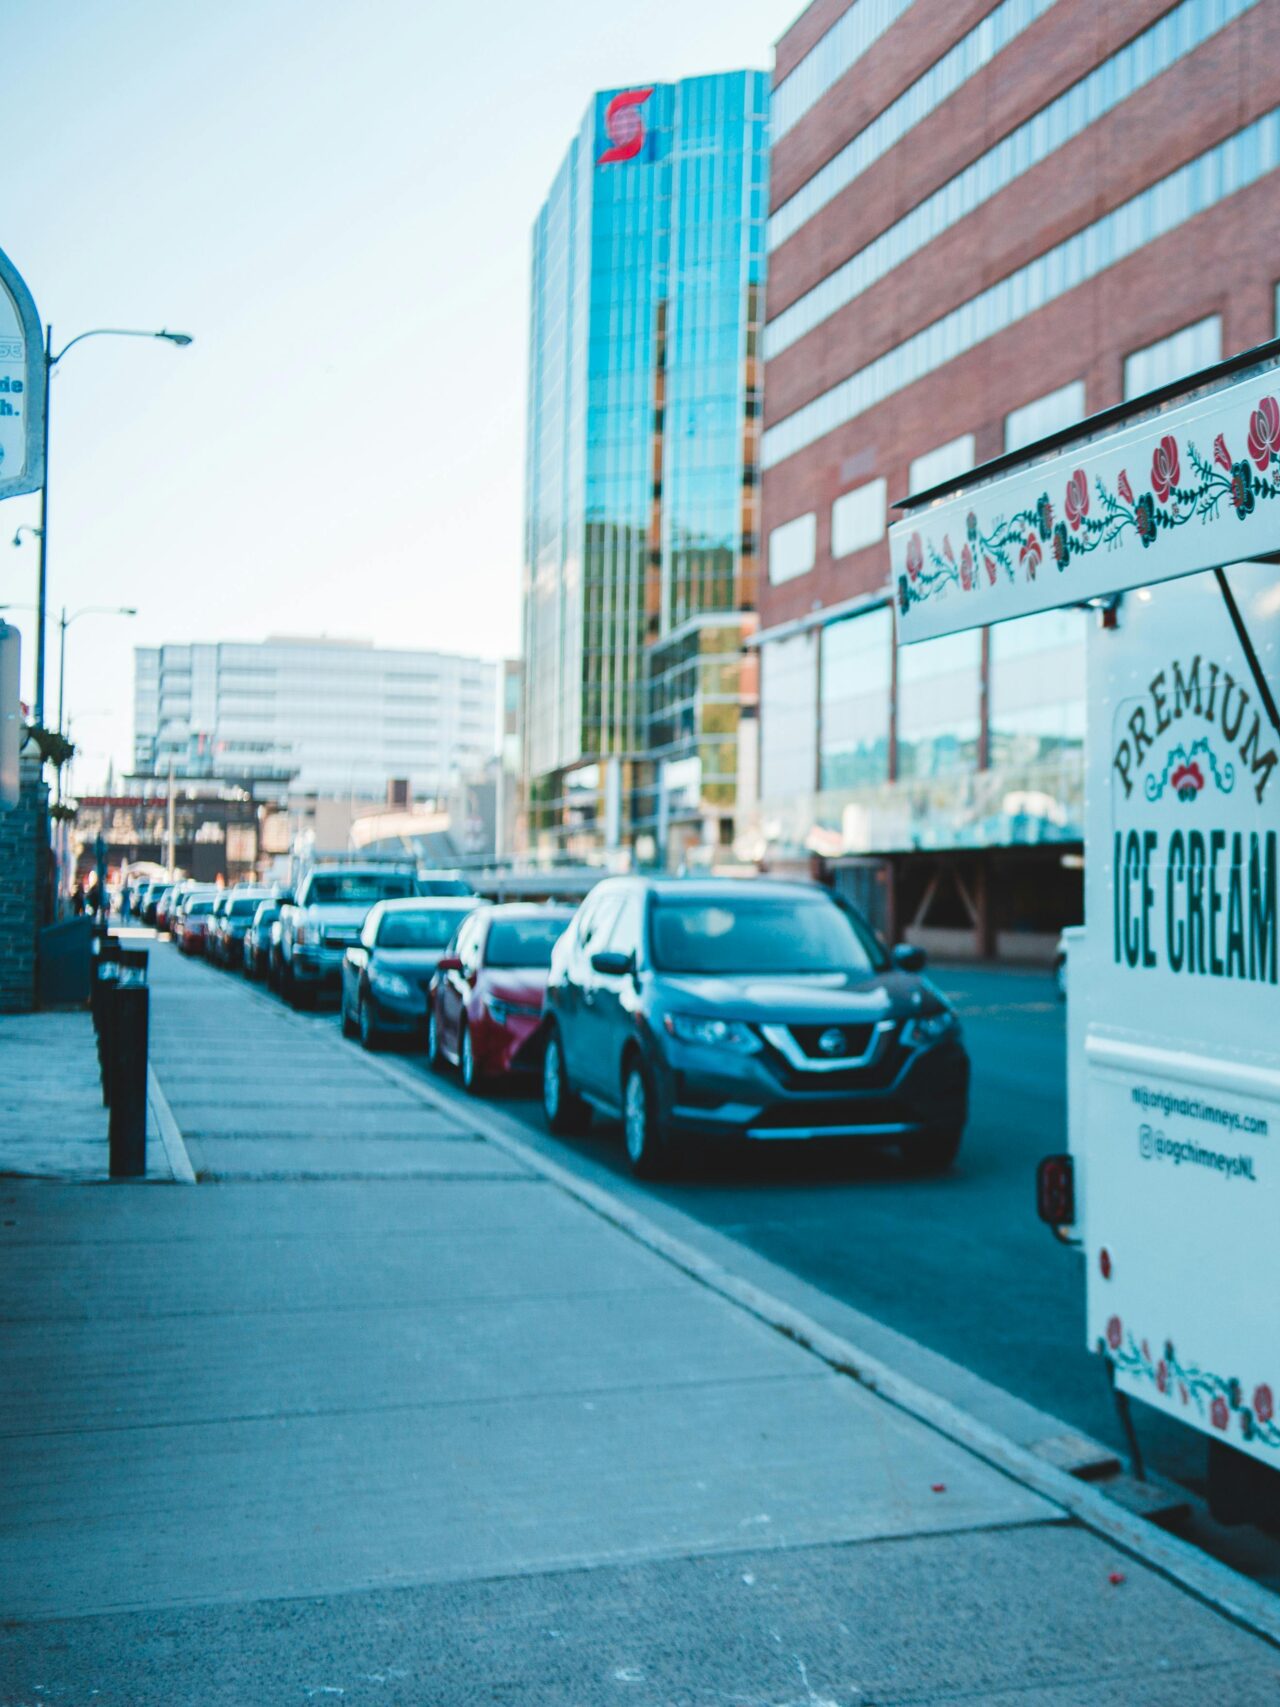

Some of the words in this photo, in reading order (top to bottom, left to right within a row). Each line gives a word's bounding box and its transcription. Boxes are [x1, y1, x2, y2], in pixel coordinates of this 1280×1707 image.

[1113, 654, 1279, 805] PREMIUM
[1114, 829, 1159, 968] ICE
[1166, 829, 1279, 985] CREAM
